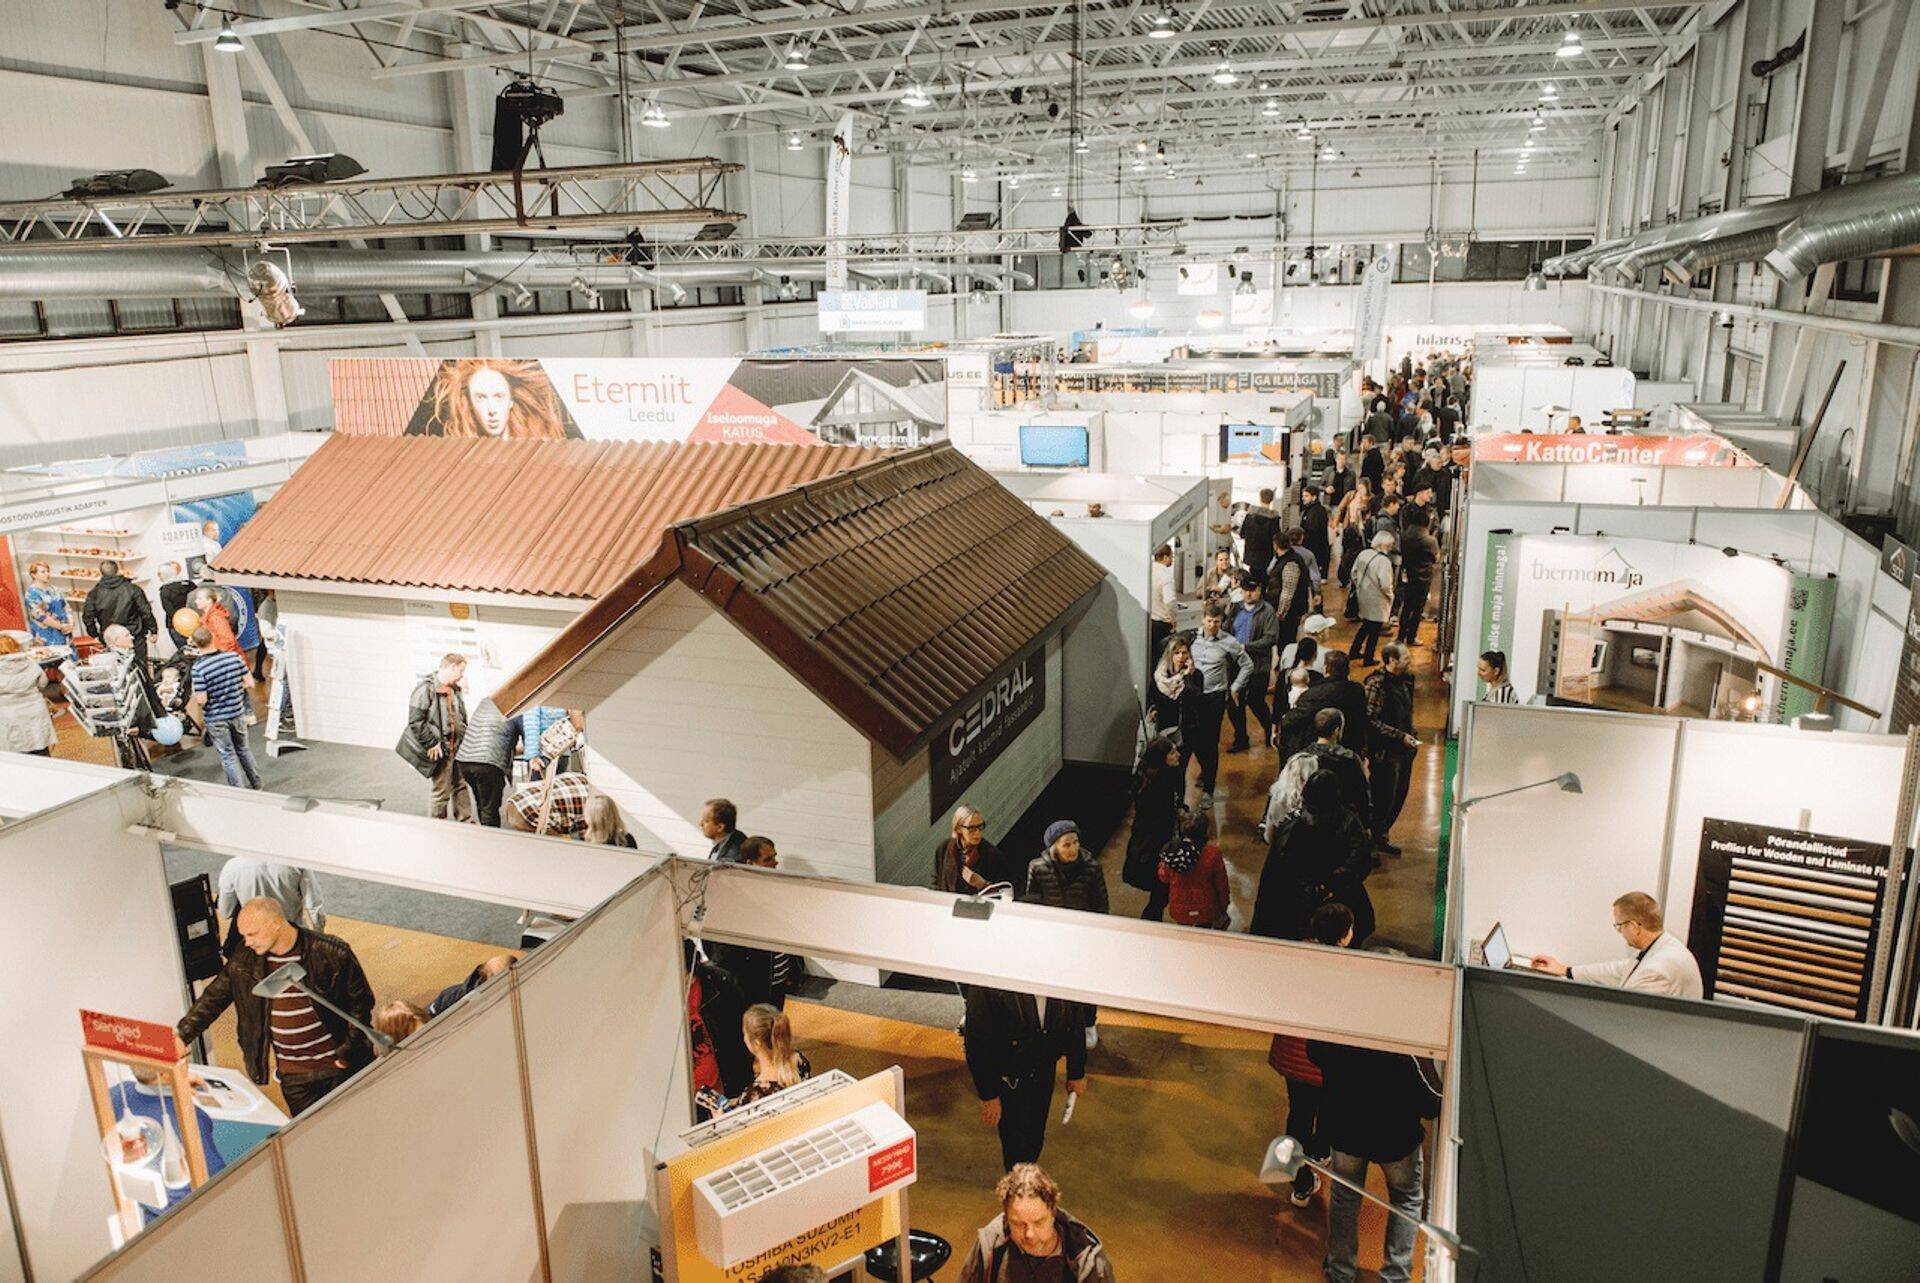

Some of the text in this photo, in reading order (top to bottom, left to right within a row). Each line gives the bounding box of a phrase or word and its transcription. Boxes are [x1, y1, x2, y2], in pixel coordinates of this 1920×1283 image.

[851, 292, 898, 309] Vaillant
[573, 373, 693, 405] Eterniit
[1254, 375, 1271, 387] GA
[628, 408, 676, 423] Leedu
[707, 411, 778, 427] Iseloomuga
[722, 427, 763, 439] KATUS
[1526, 441, 1664, 465] KattoCnter
[0, 500, 109, 525] OSTÖÖVÕRGUSTIK ADAPTER
[949, 660, 1034, 757] CEDRAL
[1711, 840, 1746, 855] Profiles
[1747, 845, 1762, 857] for
[1763, 847, 1804, 863] Wooden
[1805, 854, 1825, 867] and
[1826, 858, 1873, 876] Laminate
